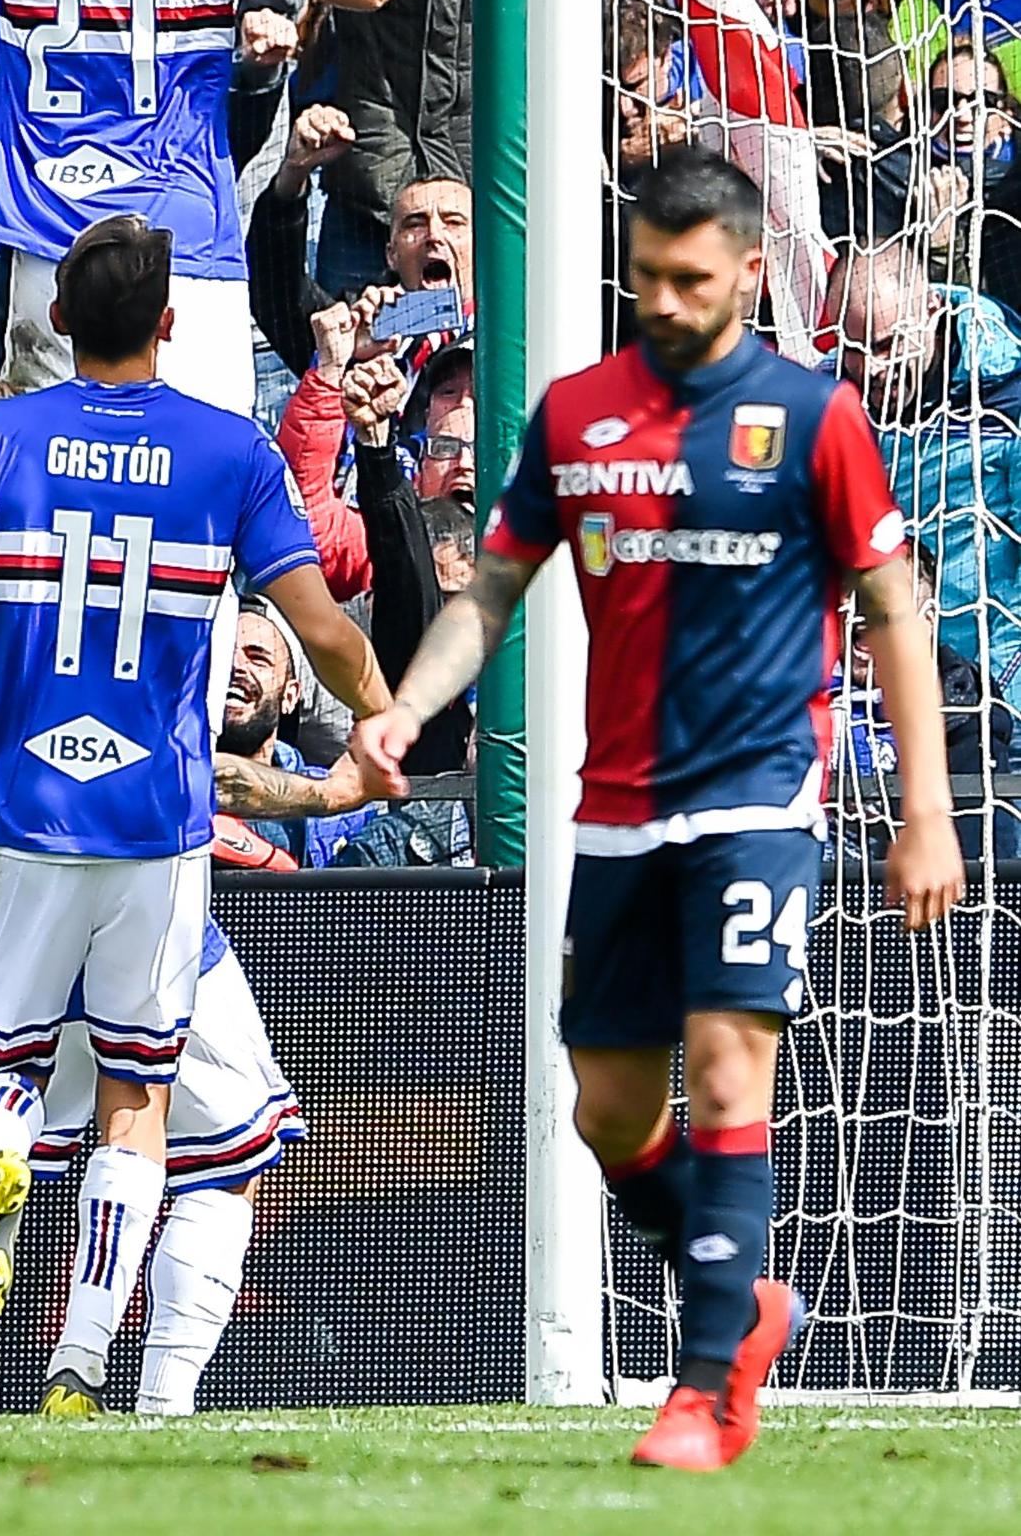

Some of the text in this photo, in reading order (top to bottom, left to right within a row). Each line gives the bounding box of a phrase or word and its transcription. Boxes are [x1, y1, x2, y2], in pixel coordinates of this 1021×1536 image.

[49, 163, 116, 184] IBSA
[46, 435, 171, 486] GASTÓN
[53, 509, 154, 681] 11
[49, 734, 122, 765] IBSA
[721, 880, 809, 971] 24
